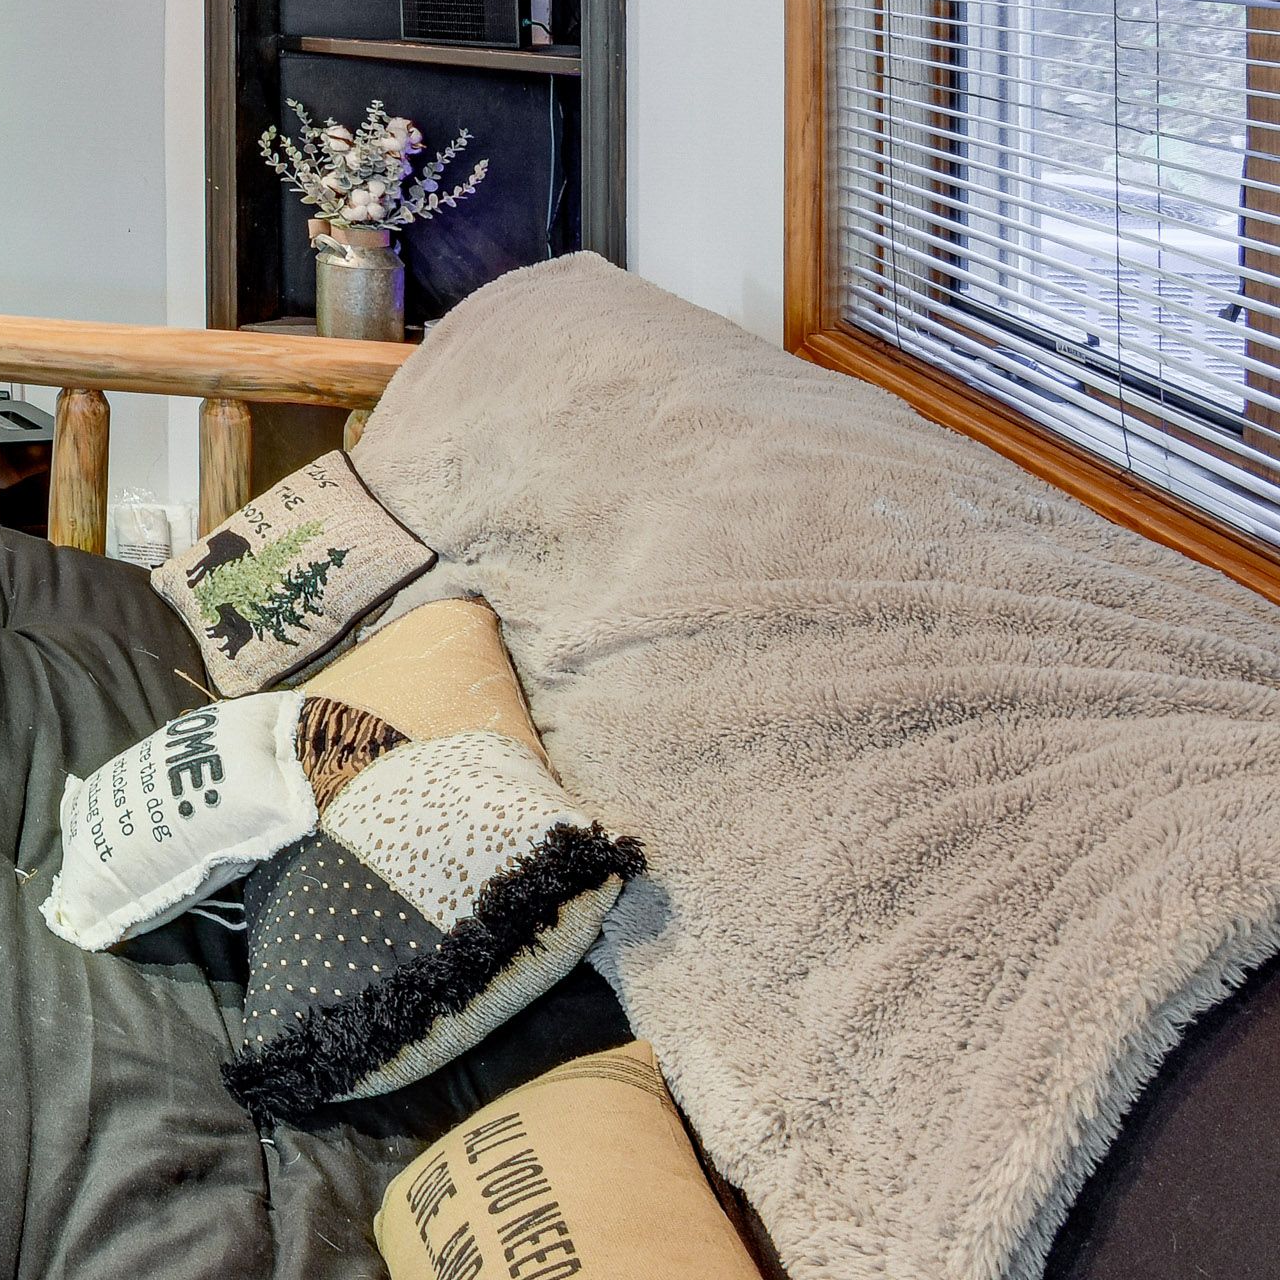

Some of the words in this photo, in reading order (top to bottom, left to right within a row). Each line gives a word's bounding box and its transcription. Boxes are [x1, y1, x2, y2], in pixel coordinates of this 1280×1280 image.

[303, 464, 339, 489] TAYS
[276, 485, 305, 511] THE
[241, 504, 272, 539] OODS.
[112, 757, 128, 808] sticks
[140, 762, 155, 794] the
[91, 817, 115, 863] but
[119, 809, 134, 837] to
[146, 798, 172, 843] dog
[462, 1112, 527, 1165] ALL
[476, 1148, 544, 1215] YOU
